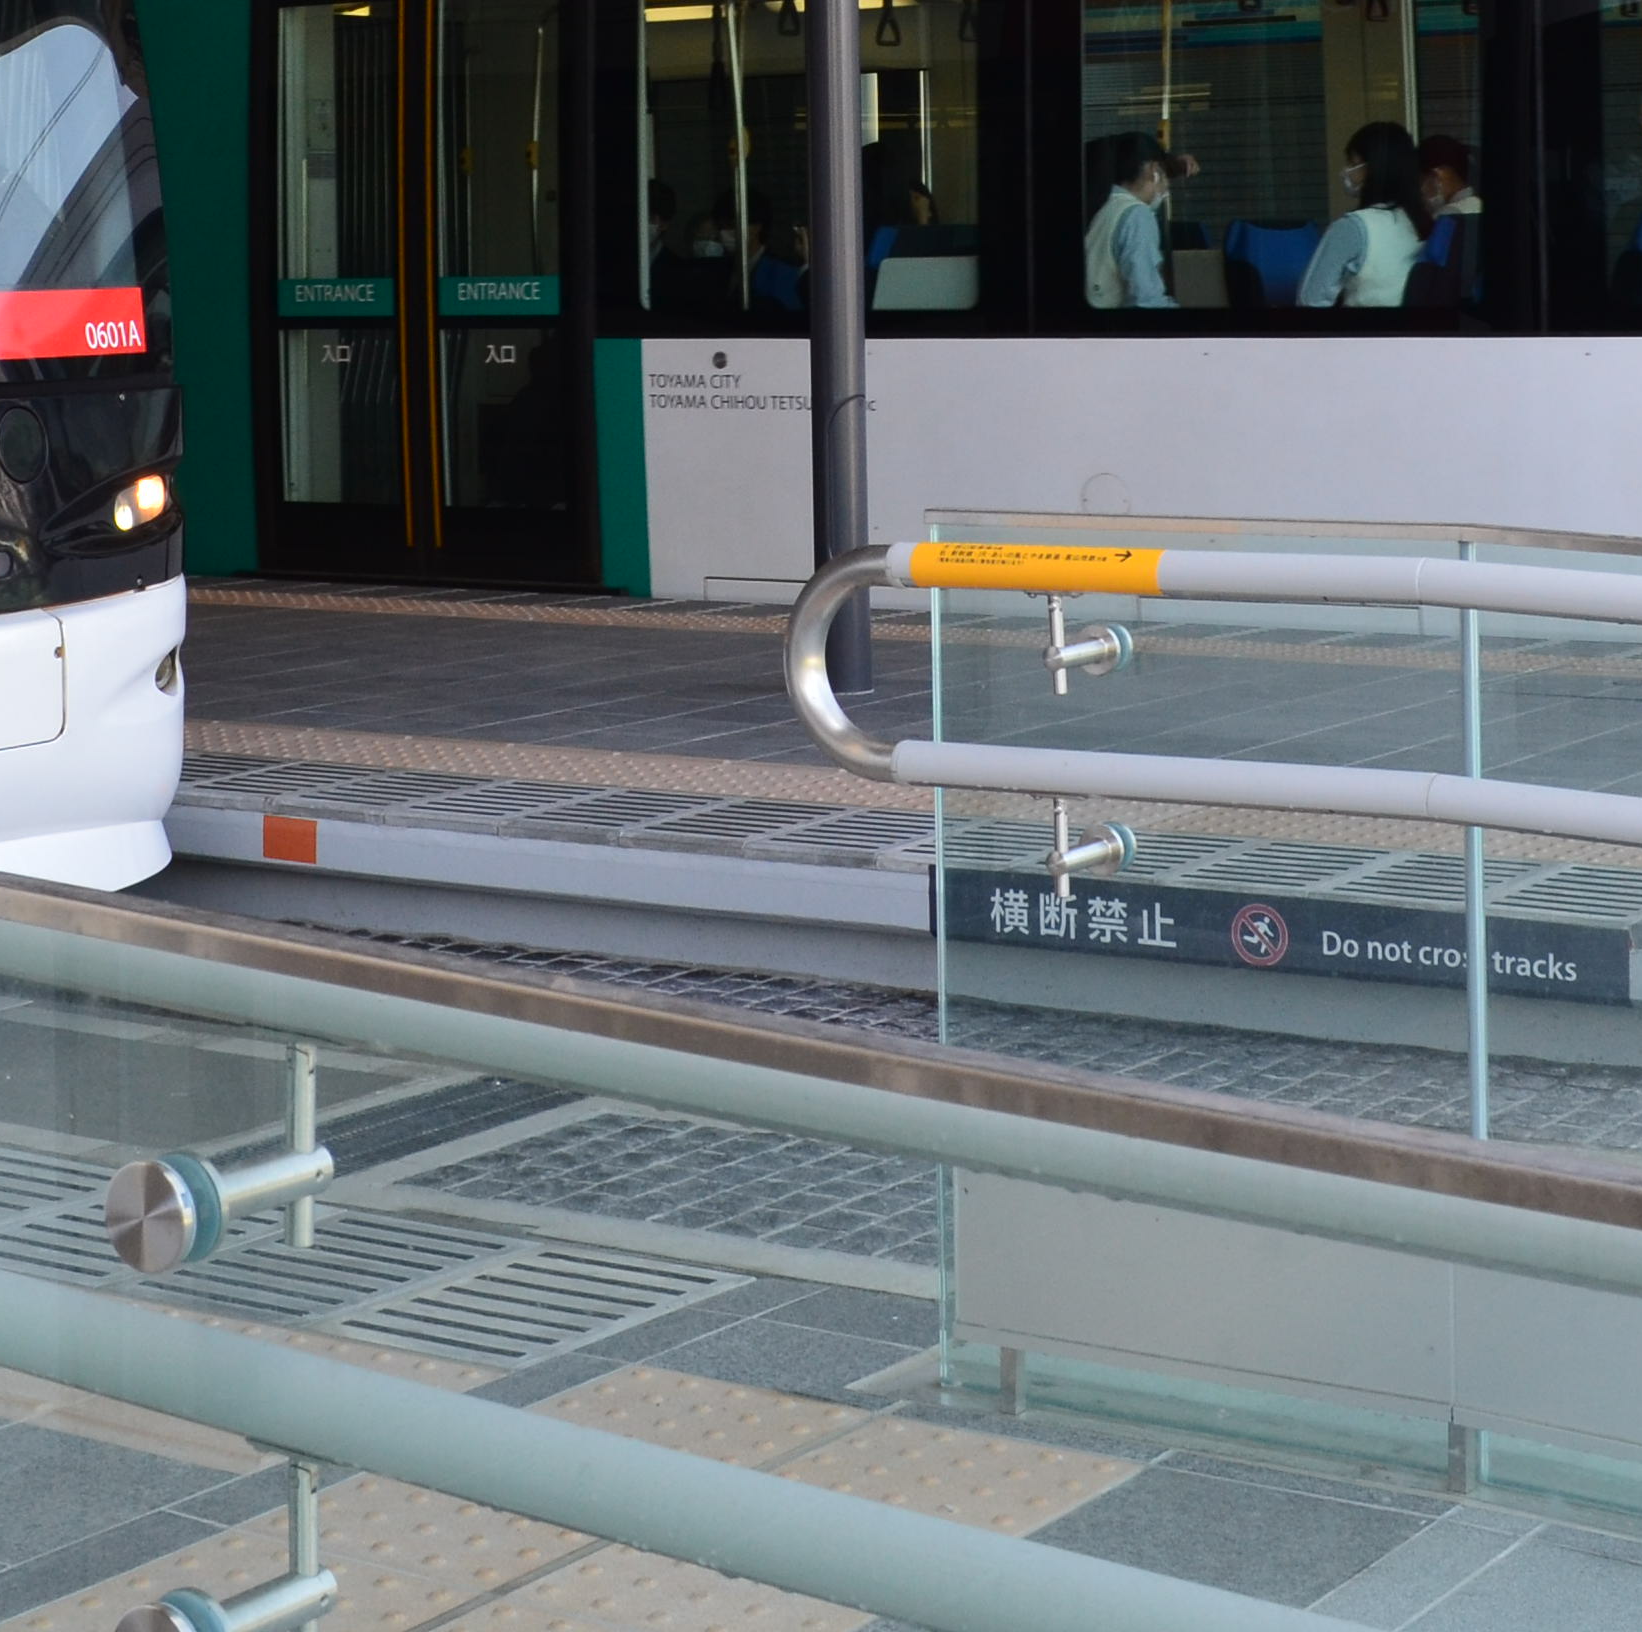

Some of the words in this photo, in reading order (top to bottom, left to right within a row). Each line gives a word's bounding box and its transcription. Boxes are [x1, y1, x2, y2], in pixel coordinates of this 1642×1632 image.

[295, 284, 375, 302] ENTRANCE
[457, 282, 541, 301] ENTRANCE
[85, 319, 142, 349] 0601A
[321, 345, 352, 363] 入口
[484, 345, 517, 363] 入口
[648, 374, 705, 388] TOYAMA
[710, 374, 742, 389] CITY
[648, 394, 706, 409] TOYAMA
[710, 395, 766, 410] CHIHOU
[990, 887, 1177, 950] 横断禁止
[1321, 930, 1359, 958] Do
[1366, 937, 1411, 965] not
[1417, 946, 1469, 969] cro
[1492, 950, 1578, 983] tracks
